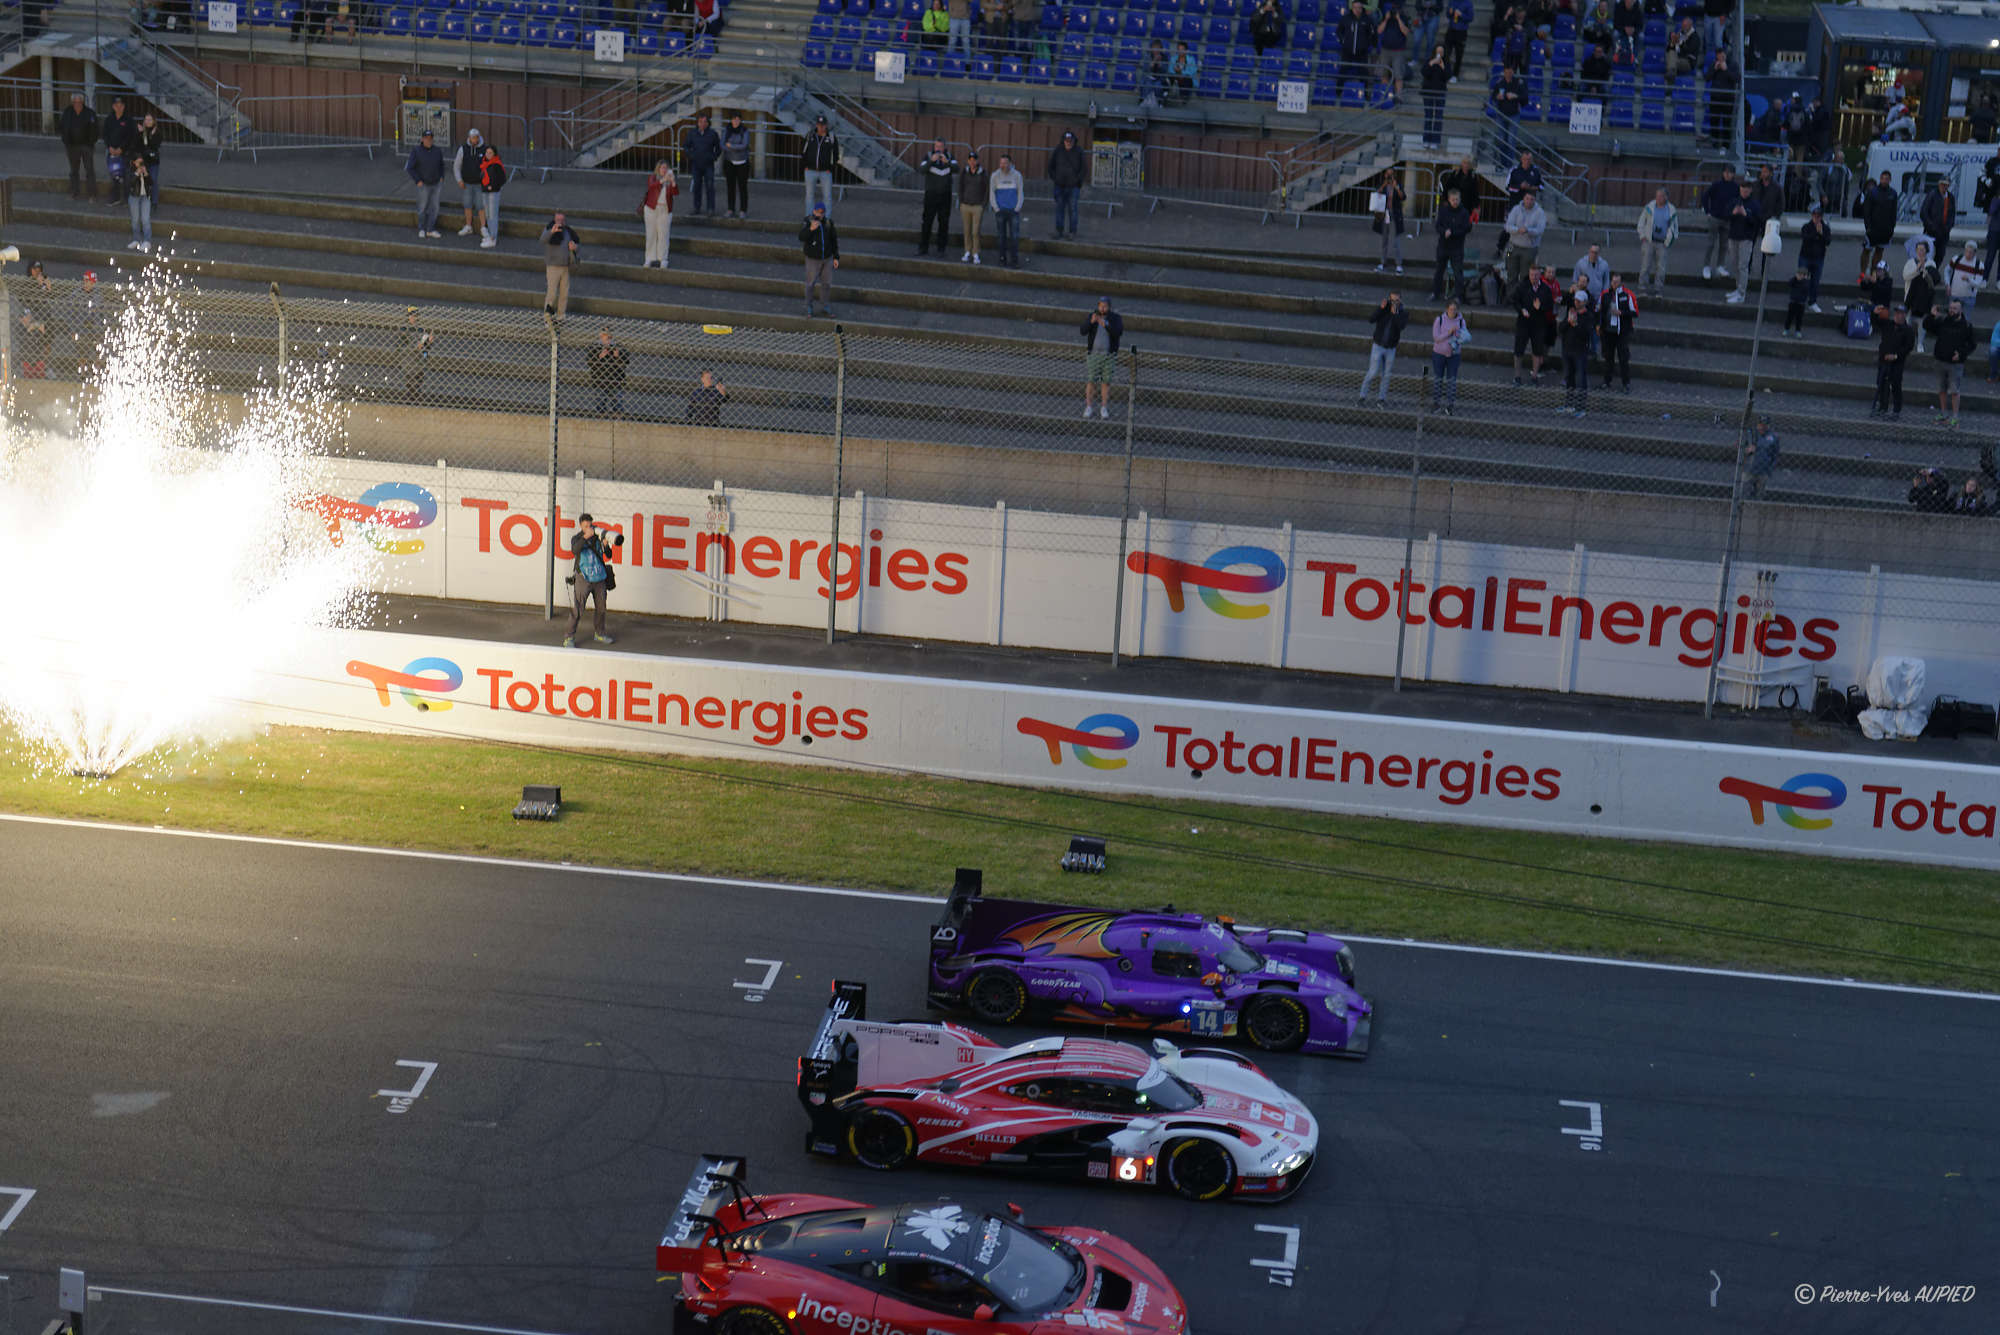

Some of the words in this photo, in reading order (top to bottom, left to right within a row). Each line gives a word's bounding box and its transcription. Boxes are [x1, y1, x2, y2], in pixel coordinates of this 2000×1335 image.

[1872, 48, 1903, 61] BAR
[1306, 560, 1840, 668] TotalEnergies
[476, 667, 870, 746] TotalEnergies
[1154, 724, 1562, 805] TotalEnergies
[1197, 1010, 1217, 1031] 14
[931, 1095, 970, 1116] Ansys
[917, 1117, 963, 1128] PENSKE
[1579, 1136, 1602, 1151] 16
[1119, 1156, 1137, 1181] 6
